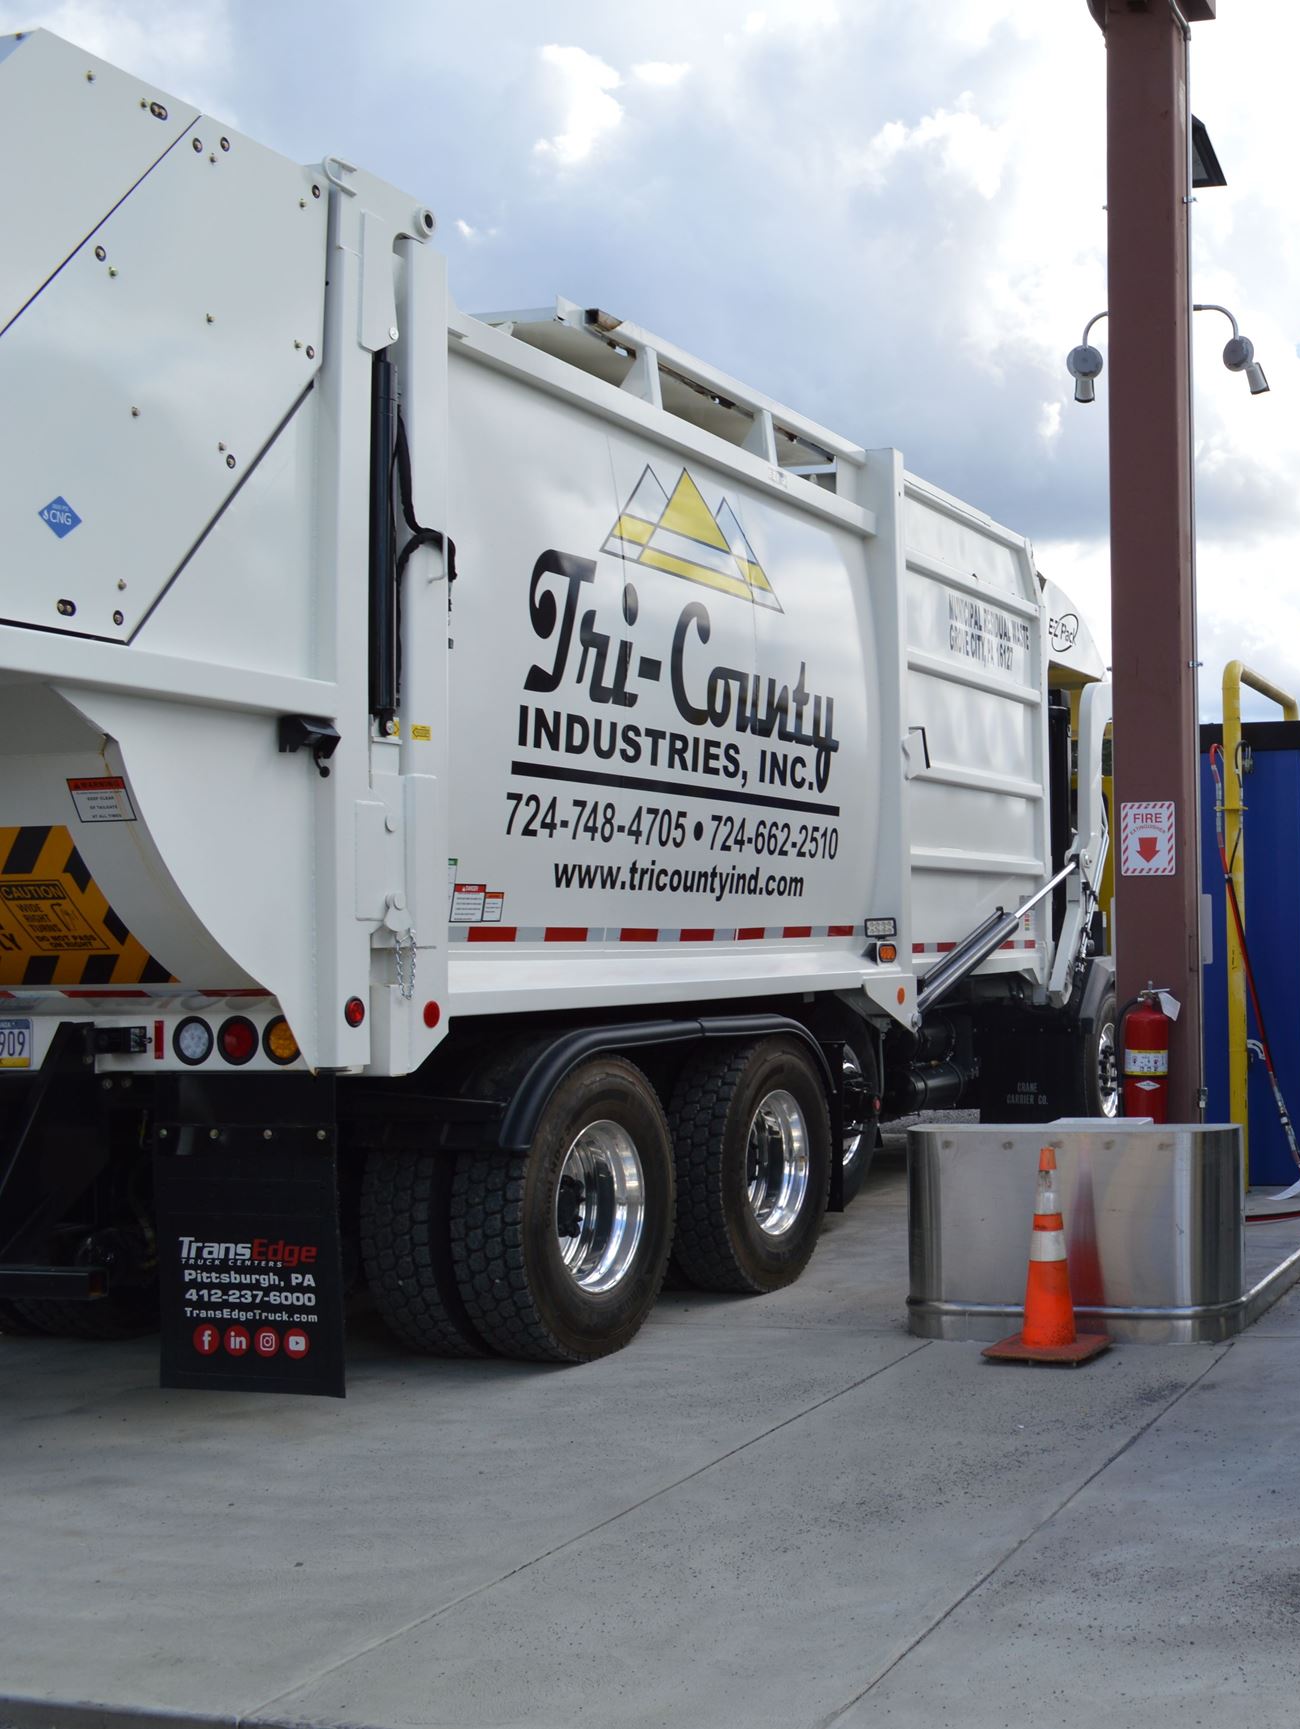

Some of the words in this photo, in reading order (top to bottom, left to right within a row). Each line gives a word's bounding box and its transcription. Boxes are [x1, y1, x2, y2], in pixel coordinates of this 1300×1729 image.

[50, 510, 72, 525] CNG
[523, 548, 840, 793] Tri-County
[517, 704, 748, 788] INDUSTRIES,
[758, 749, 814, 790] INC.
[504, 792, 687, 848] 724-748-4705
[709, 814, 839, 860] 724-662-2510
[1133, 812, 1162, 823] FIRE
[553, 858, 804, 902] www.tricountyind.com
[1, 885, 65, 898] CAUTION
[178, 1236, 318, 1268] TransEdge
[228, 1259, 283, 1267] CENTERS
[184, 1269, 285, 1287] Pittsburgh,
[290, 1273, 316, 1287] PA
[184, 1288, 317, 1306] 412-237-6000
[184, 1307, 318, 1322] TransEdgeTruck.com
